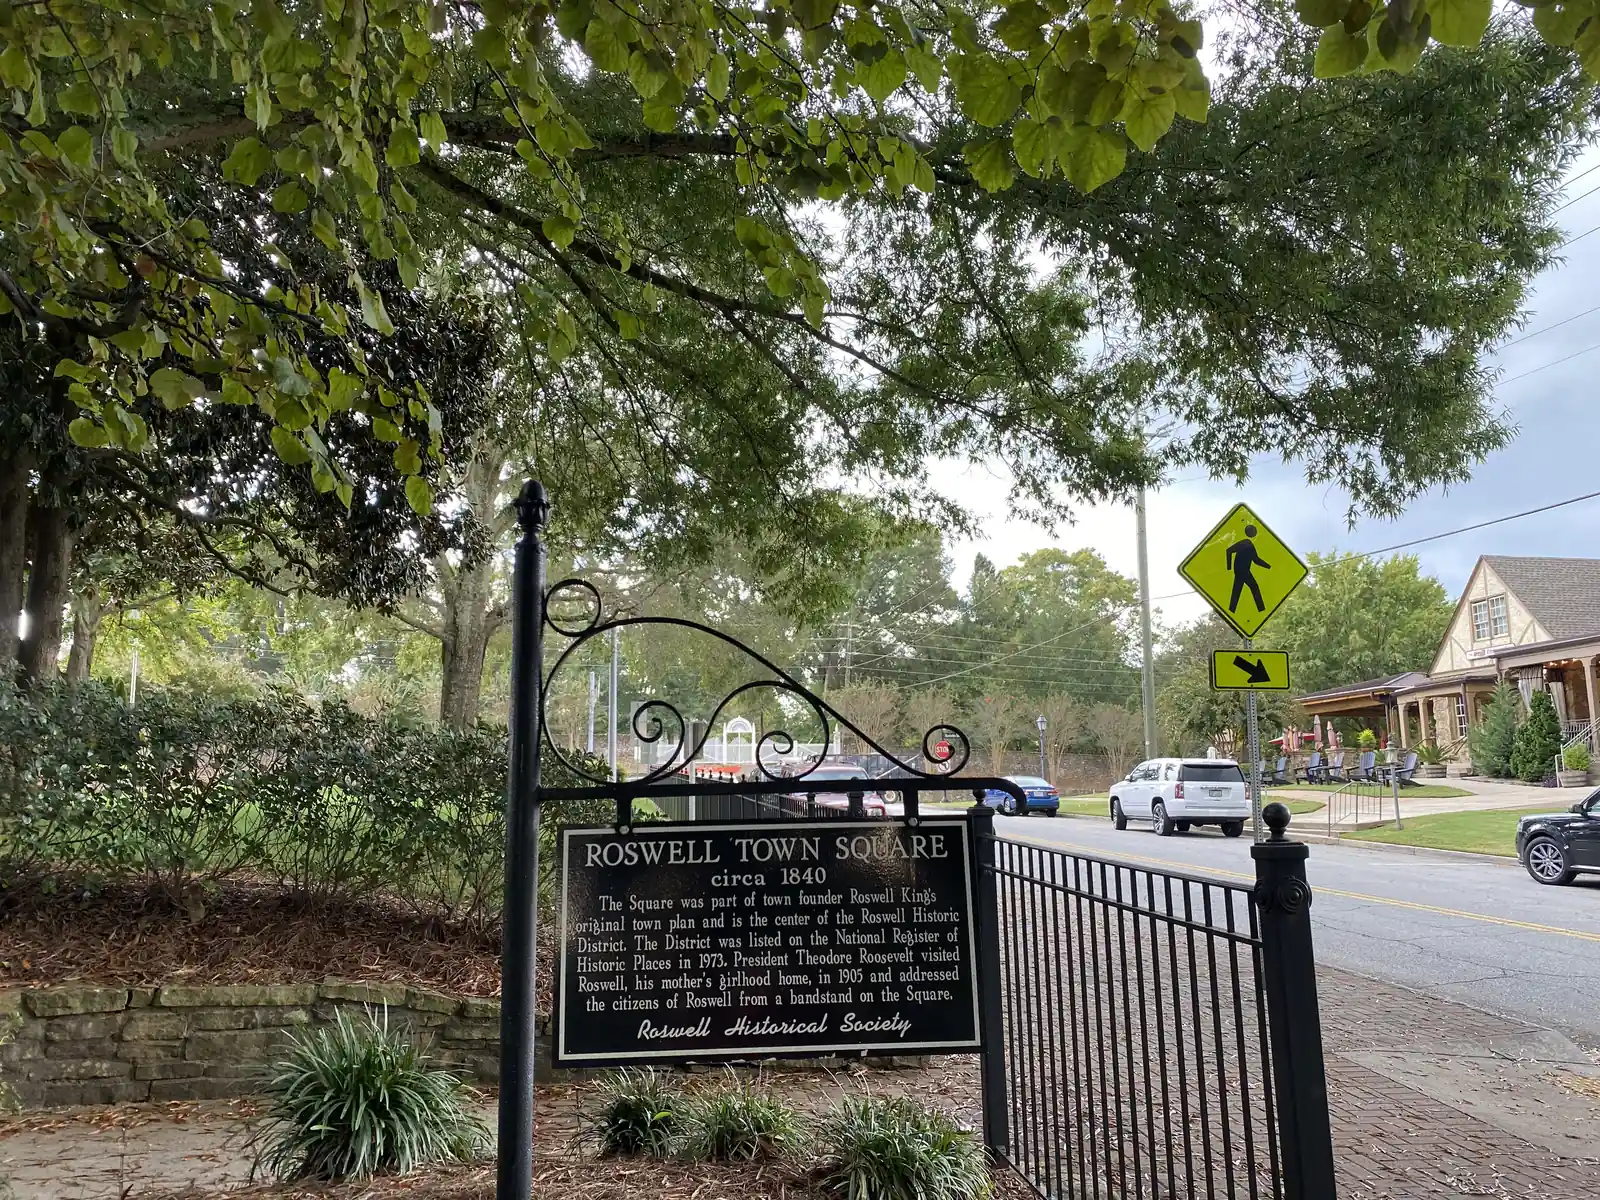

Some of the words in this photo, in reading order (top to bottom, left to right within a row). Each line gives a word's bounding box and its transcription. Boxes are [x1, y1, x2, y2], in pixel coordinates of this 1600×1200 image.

[585, 840, 720, 867] ROSWELL
[734, 837, 820, 862] TOWN
[836, 835, 948, 863] SQUARE
[711, 869, 766, 887] circa
[780, 867, 827, 885] 1840
[599, 895, 622, 912] The
[630, 894, 673, 913] Square
[681, 898, 704, 908] was
[711, 895, 737, 910] part
[744, 892, 756, 907] of
[763, 893, 792, 906] town
[799, 889, 843, 905] founder
[850, 888, 894, 904] Roswell
[901, 887, 936, 906] King's
[576, 916, 625, 936] original
[632, 918, 662, 931] town
[670, 914, 696, 934] plan
[702, 912, 724, 928] and
[732, 914, 742, 928] is
[750, 911, 768, 926] the
[774, 912, 810, 926] center
[817, 910, 829, 925] of
[836, 908, 854, 924] the
[861, 908, 905, 924] Roswell
[913, 906, 960, 923] Historic
[578, 937, 626, 953] District.
[634, 935, 658, 951] The
[665, 934, 710, 950] District
[718, 936, 742, 948] was
[749, 931, 782, 948] listed
[789, 934, 802, 946] on
[810, 930, 828, 946] the
[836, 928, 886, 945] National
[892, 927, 940, 946] Register
[947, 927, 958, 942] of
[577, 956, 625, 973] Historic
[633, 954, 672, 971] Places
[679, 954, 692, 970] in
[699, 954, 728, 969] 1973.
[734, 951, 788, 968] President
[796, 949, 852, 966] Theodore
[860, 947, 914, 964] Roosevelt
[921, 946, 960, 962] visited
[578, 976, 628, 992] Roswell,
[635, 975, 654, 990] his
[661, 972, 712, 990] mother's
[720, 970, 771, 990] girlhood
[778, 970, 812, 986] home,
[818, 970, 831, 984] in
[838, 968, 863, 984] 1905
[870, 967, 892, 983] and
[900, 965, 960, 982] addressed
[586, 996, 604, 1012] the
[612, 995, 658, 1010] citizens
[666, 993, 678, 1009] of
[686, 992, 732, 1008] Roswell
[740, 990, 768, 1006] from
[776, 994, 782, 1005] a
[790, 987, 852, 1004] bandstand
[860, 991, 874, 1002] on
[882, 986, 900, 1002] the
[906, 985, 953, 1004] Square.
[637, 1017, 712, 1040] Roswell
[724, 1013, 828, 1036] Historical
[840, 1012, 912, 1038] Society
